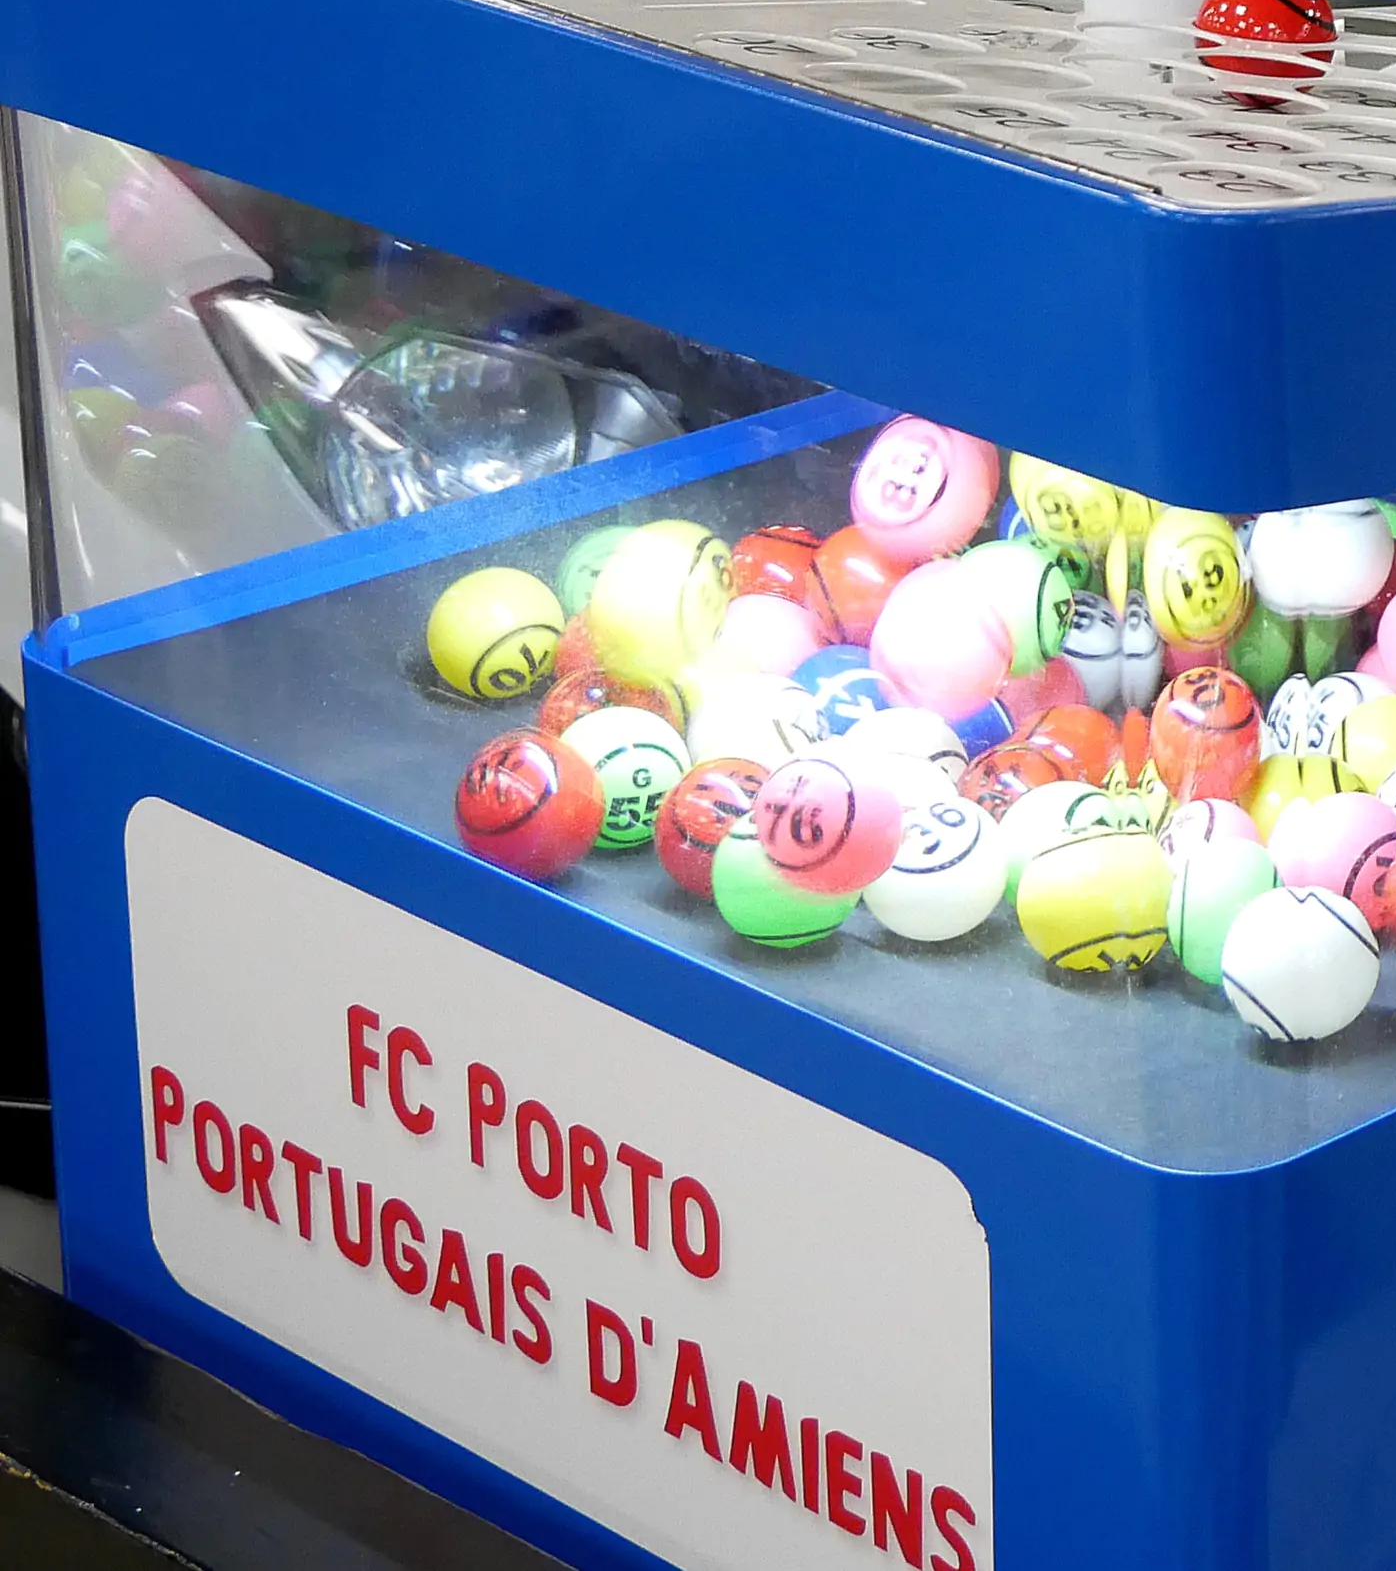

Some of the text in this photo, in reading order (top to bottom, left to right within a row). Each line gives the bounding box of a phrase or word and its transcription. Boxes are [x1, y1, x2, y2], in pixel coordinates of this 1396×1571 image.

[1188, 131, 1291, 152] 34
[1179, 169, 1293, 191] 23
[631, 767, 653, 789] G
[347, 1003, 721, 1279] FC PORTO
[150, 1065, 977, 1571] PORTUGAIS D'AMIENS
